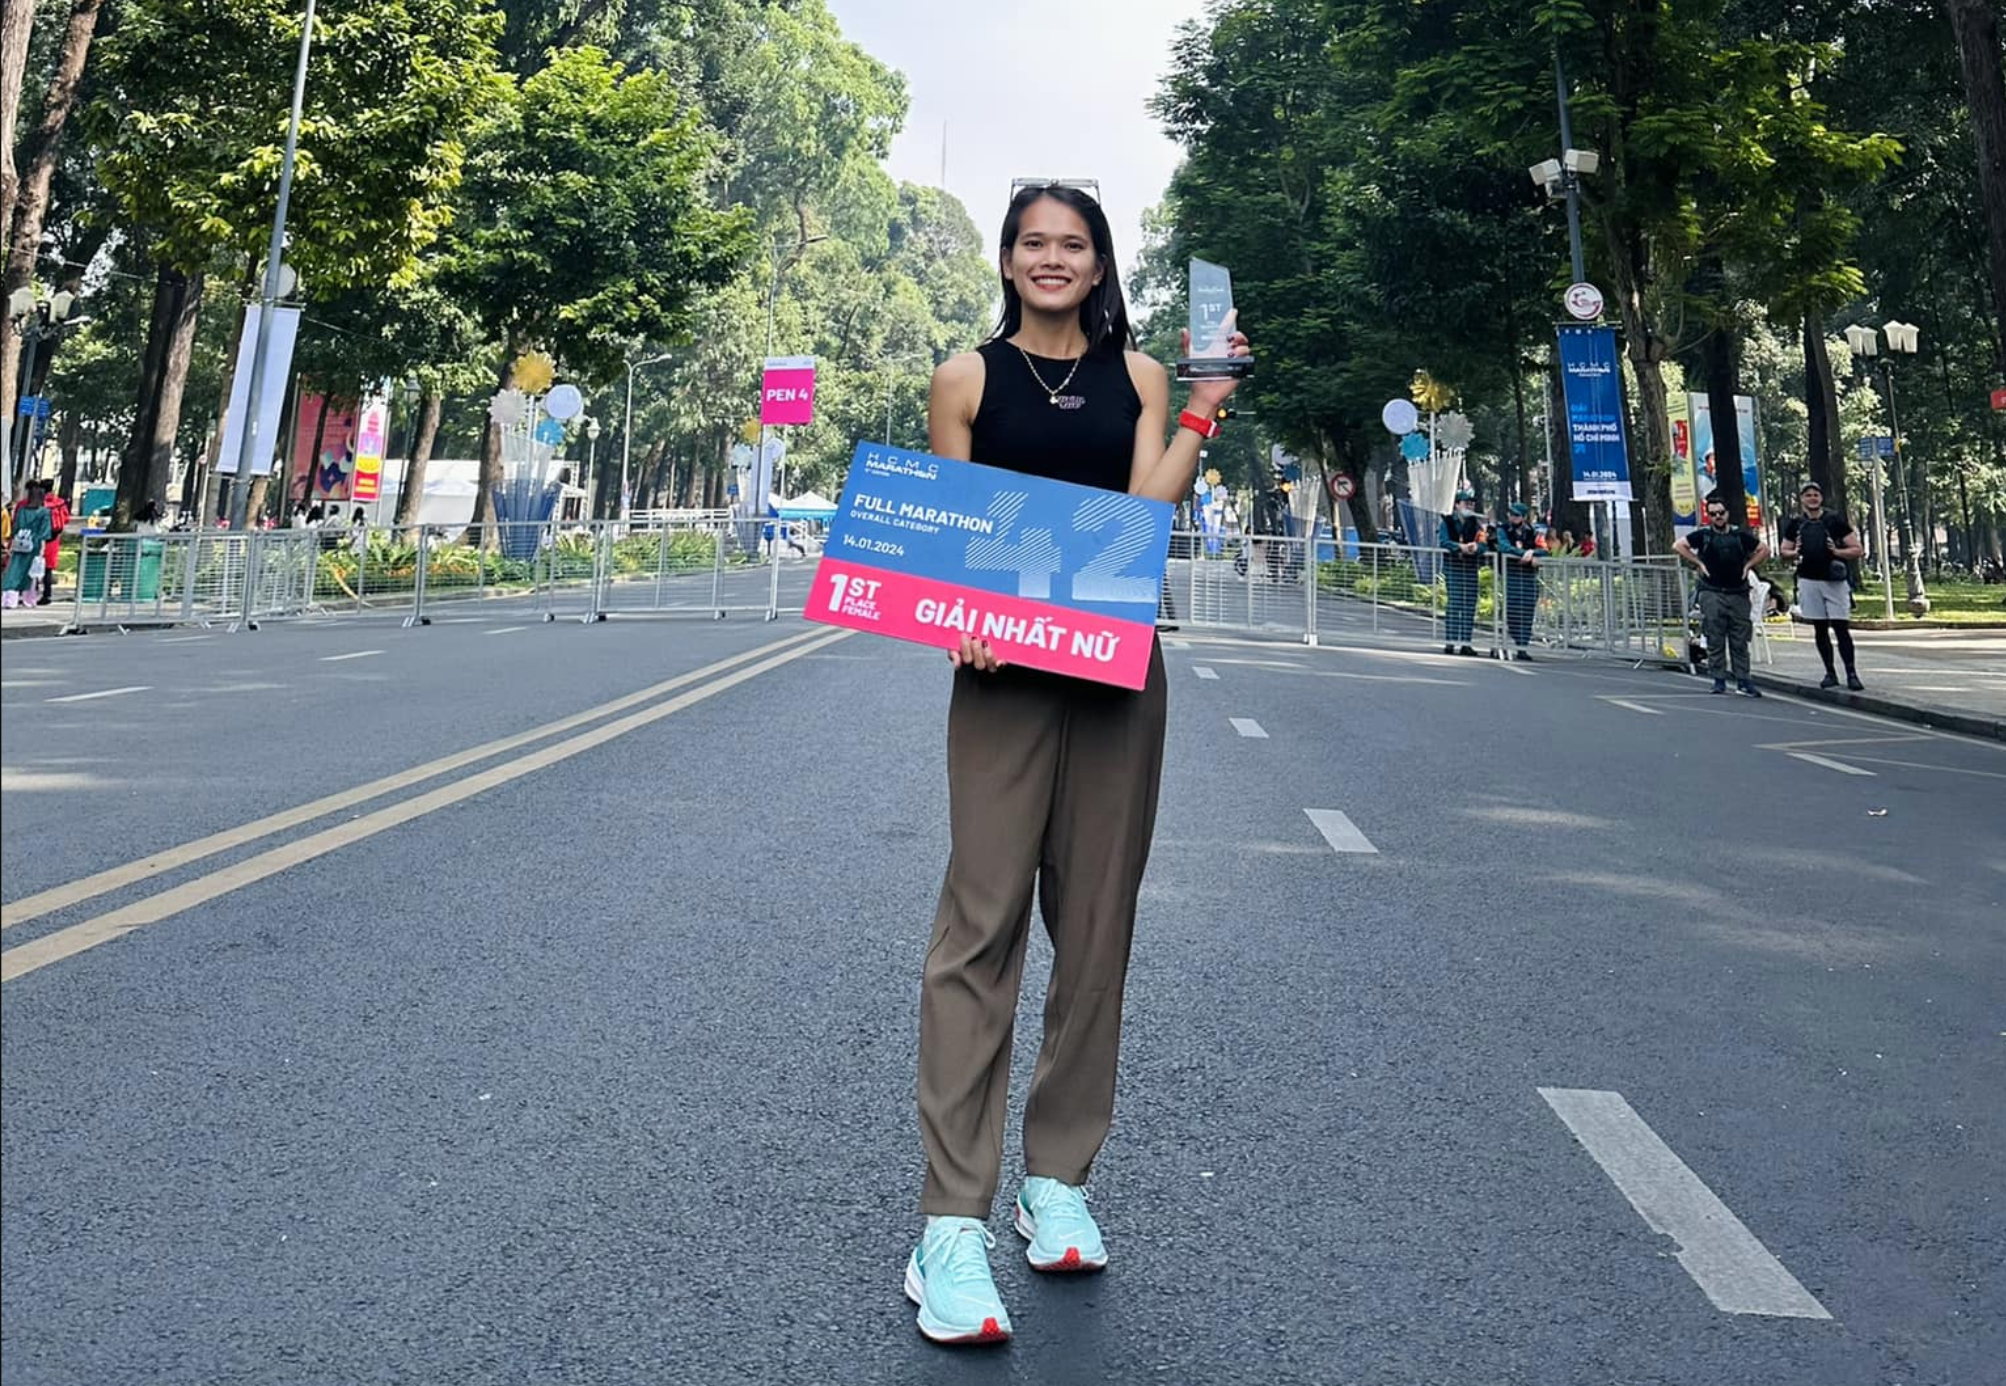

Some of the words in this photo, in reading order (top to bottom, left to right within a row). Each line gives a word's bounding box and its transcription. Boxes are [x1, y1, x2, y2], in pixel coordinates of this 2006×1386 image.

[766, 388, 796, 402] PEN
[798, 388, 809, 401] 4
[865, 460, 938, 480] MARATHON
[850, 509, 892, 525] OVERALL
[893, 518, 941, 535] CATEGORY
[854, 493, 896, 515] FULL
[899, 502, 994, 535] MARATHON
[842, 533, 905, 557] 14.01.2024
[965, 491, 1158, 604] 42
[841, 604, 882, 621] FEMALE
[844, 596, 878, 610] PLACE
[915, 597, 979, 634] GIẢI
[981, 611, 1068, 652] NHẤT
[1070, 630, 1121, 662] NỮ
